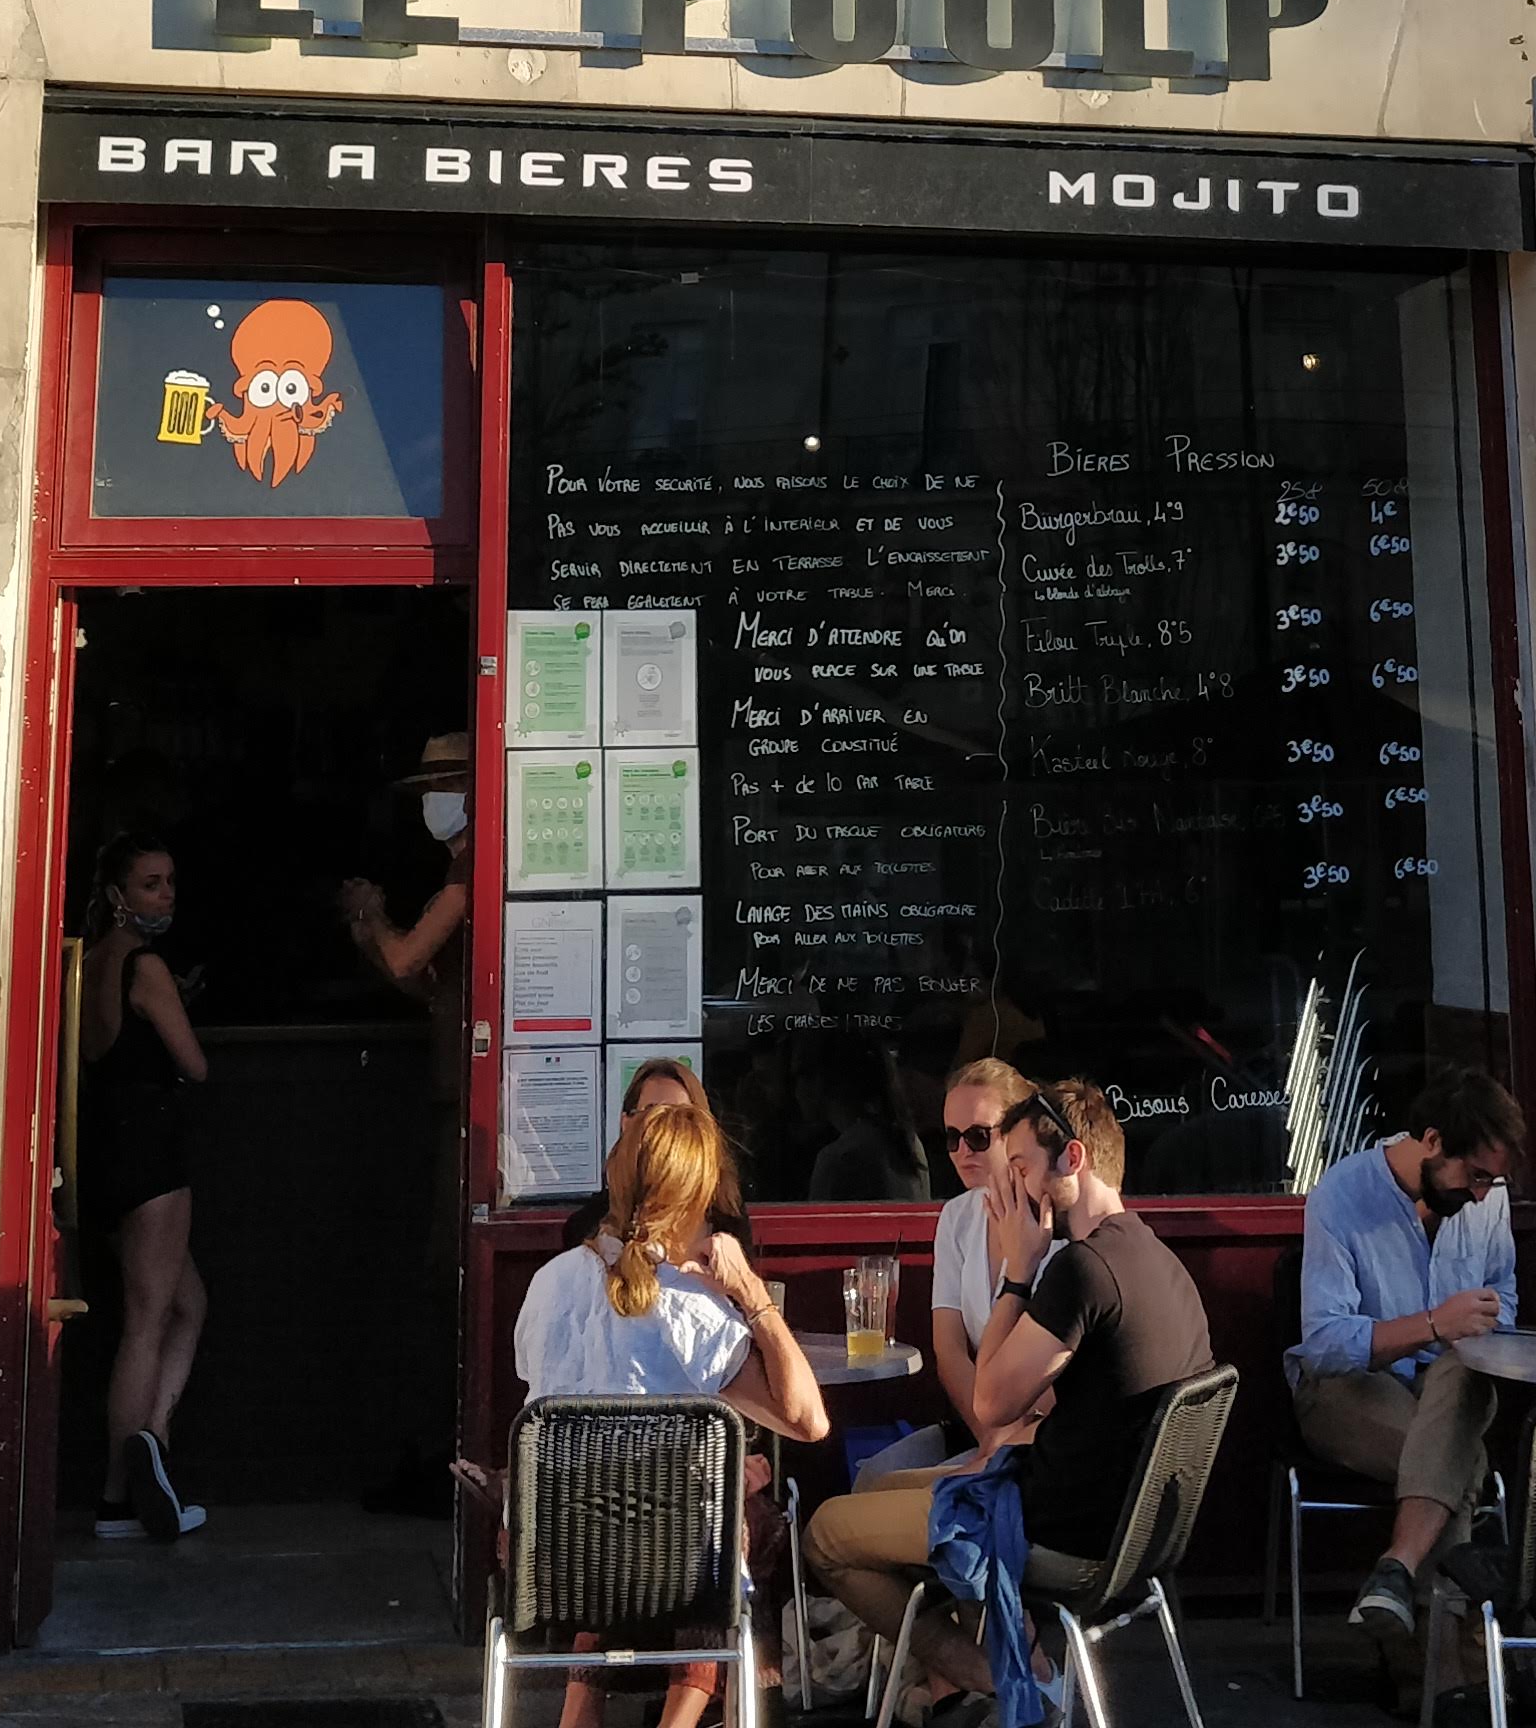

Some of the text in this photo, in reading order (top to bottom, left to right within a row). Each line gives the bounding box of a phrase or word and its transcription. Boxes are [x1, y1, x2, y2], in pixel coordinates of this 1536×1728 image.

[97, 134, 755, 193] BAR A BIERES
[1048, 170, 1360, 219] MOJITO
[1106, 1084, 1189, 1122] Bisous
